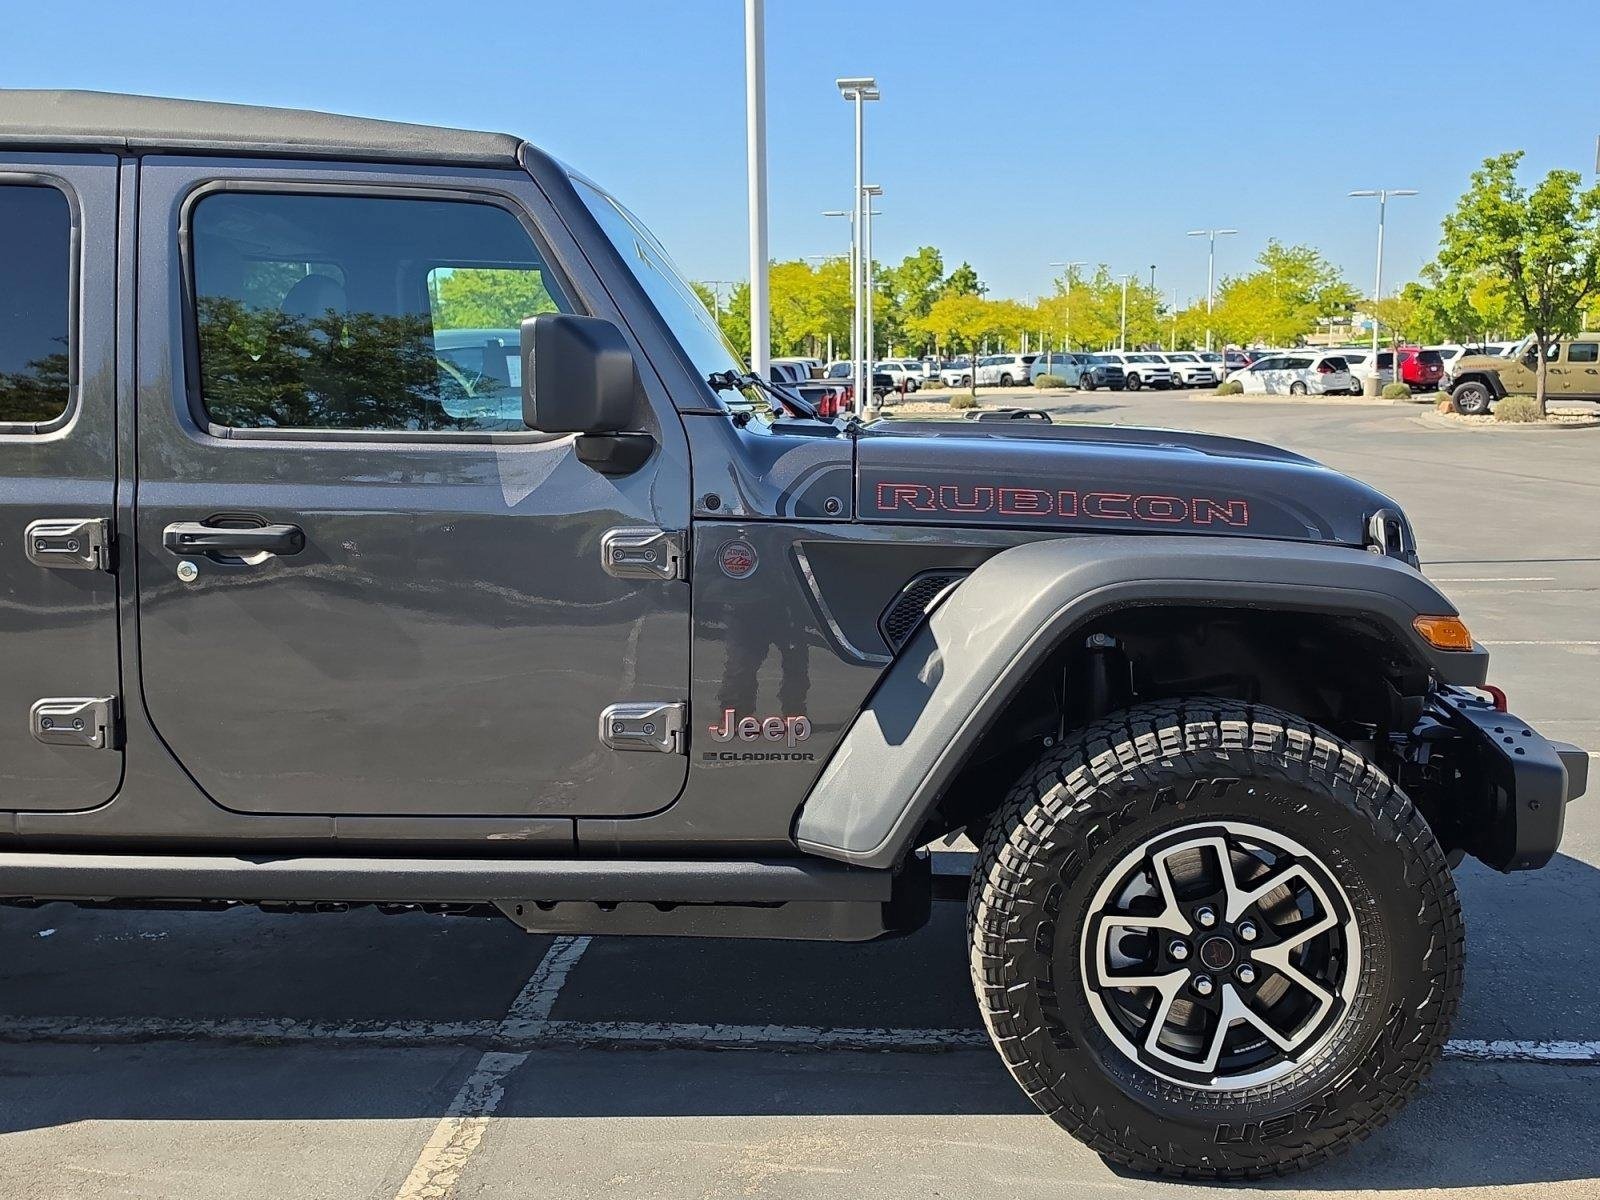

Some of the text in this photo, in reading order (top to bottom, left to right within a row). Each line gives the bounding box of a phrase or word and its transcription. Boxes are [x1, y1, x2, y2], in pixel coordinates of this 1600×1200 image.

[876, 483, 1249, 527] RUBICON
[708, 708, 812, 748] Jeep
[719, 752, 815, 761] GLADIATOR
[1149, 777, 1241, 815] A/T
